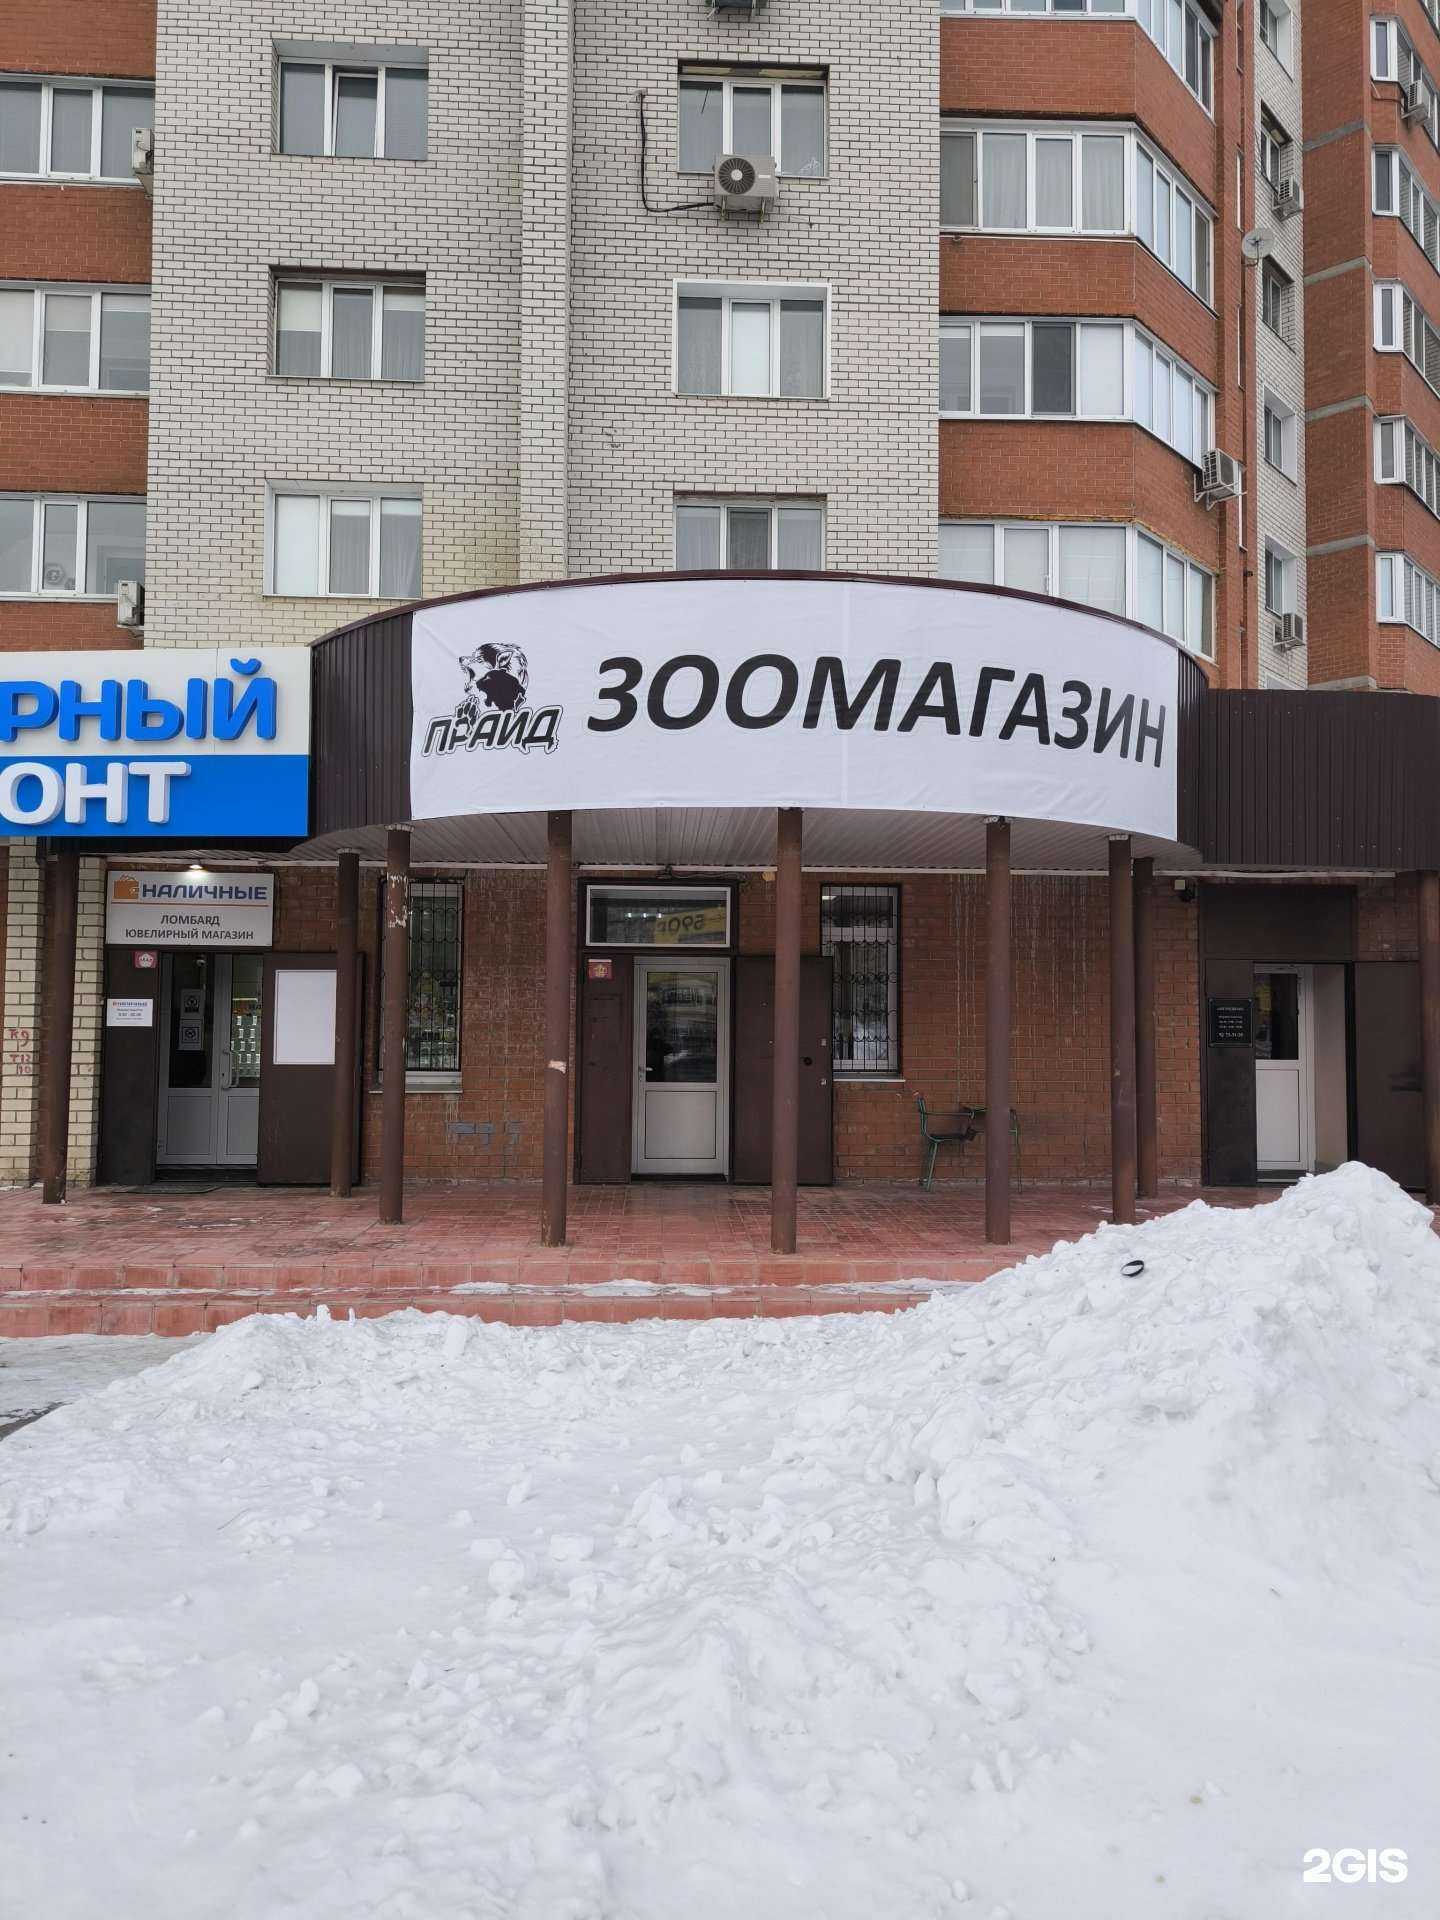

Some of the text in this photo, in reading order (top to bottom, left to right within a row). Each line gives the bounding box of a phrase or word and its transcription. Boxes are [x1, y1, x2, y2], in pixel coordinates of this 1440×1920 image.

[0, 658, 278, 742] РНЫЙ
[587, 654, 1167, 768] ЗООМАГАЗИН
[0, 761, 191, 825] ОНТ
[142, 884, 268, 900] НАЛИЧНЫЕ
[125, 928, 254, 940] ЮВЕЛИРНЫЙ МАГАЗИН
[160, 914, 221, 927] ЛОМБАРД
